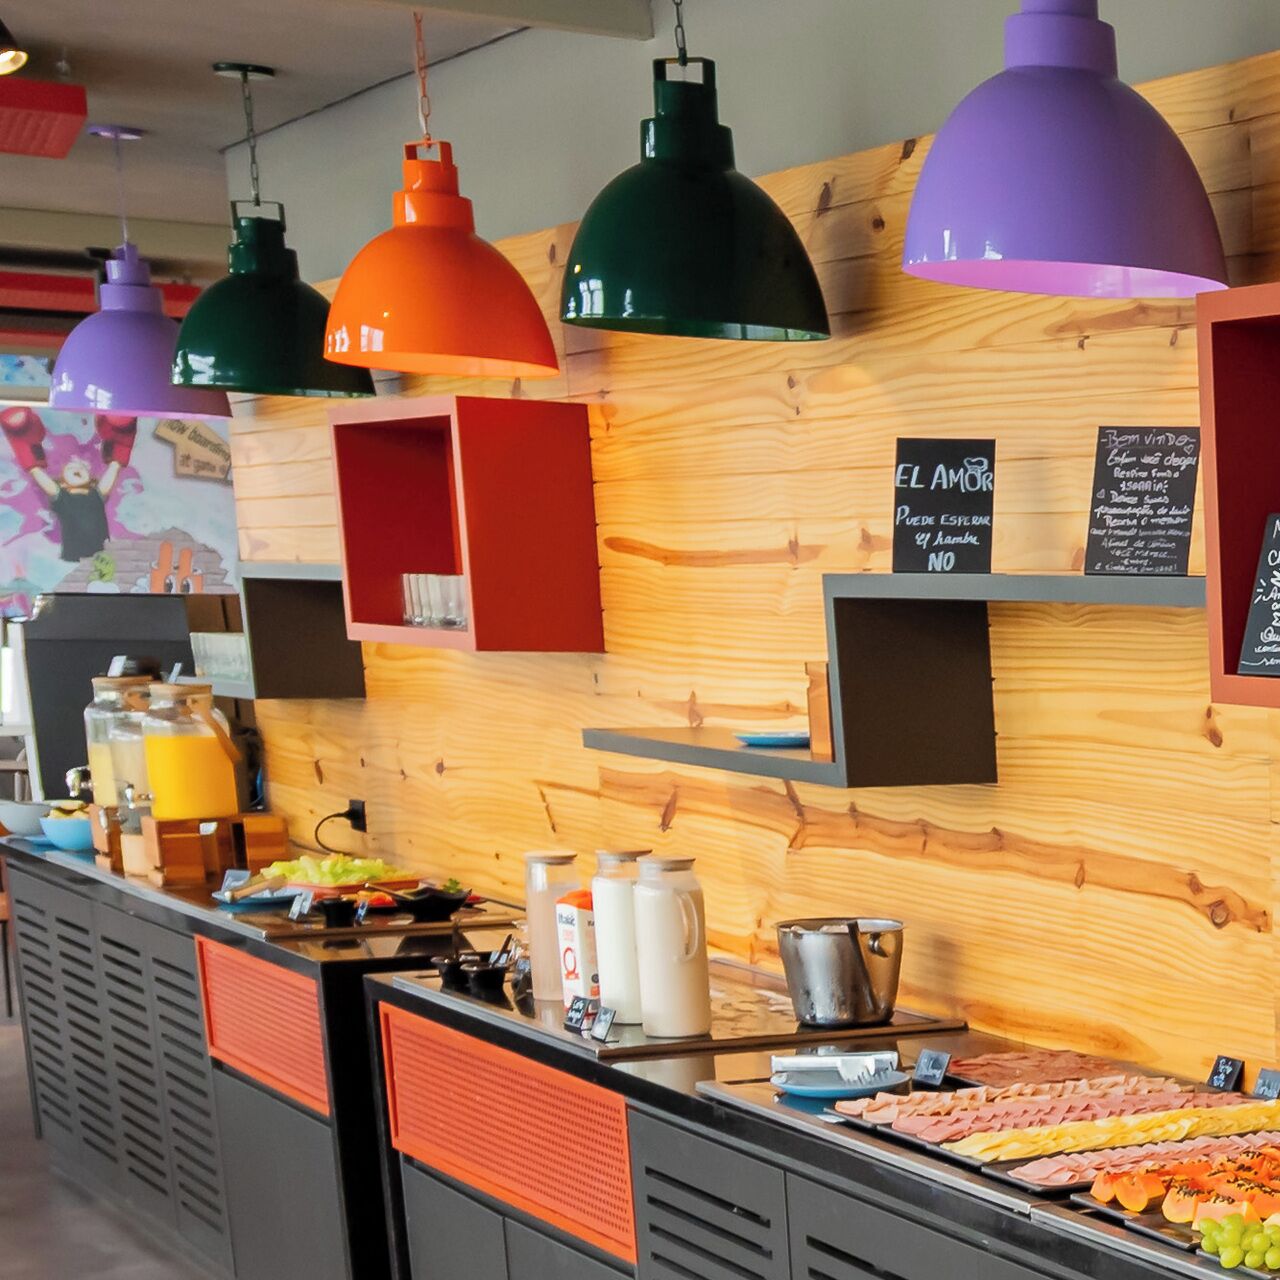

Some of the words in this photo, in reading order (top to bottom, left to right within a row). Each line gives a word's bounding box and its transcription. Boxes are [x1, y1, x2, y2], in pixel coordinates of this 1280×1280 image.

[895, 464, 925, 488] EL
[930, 464, 993, 493] AMOR
[928, 551, 955, 572] NO
